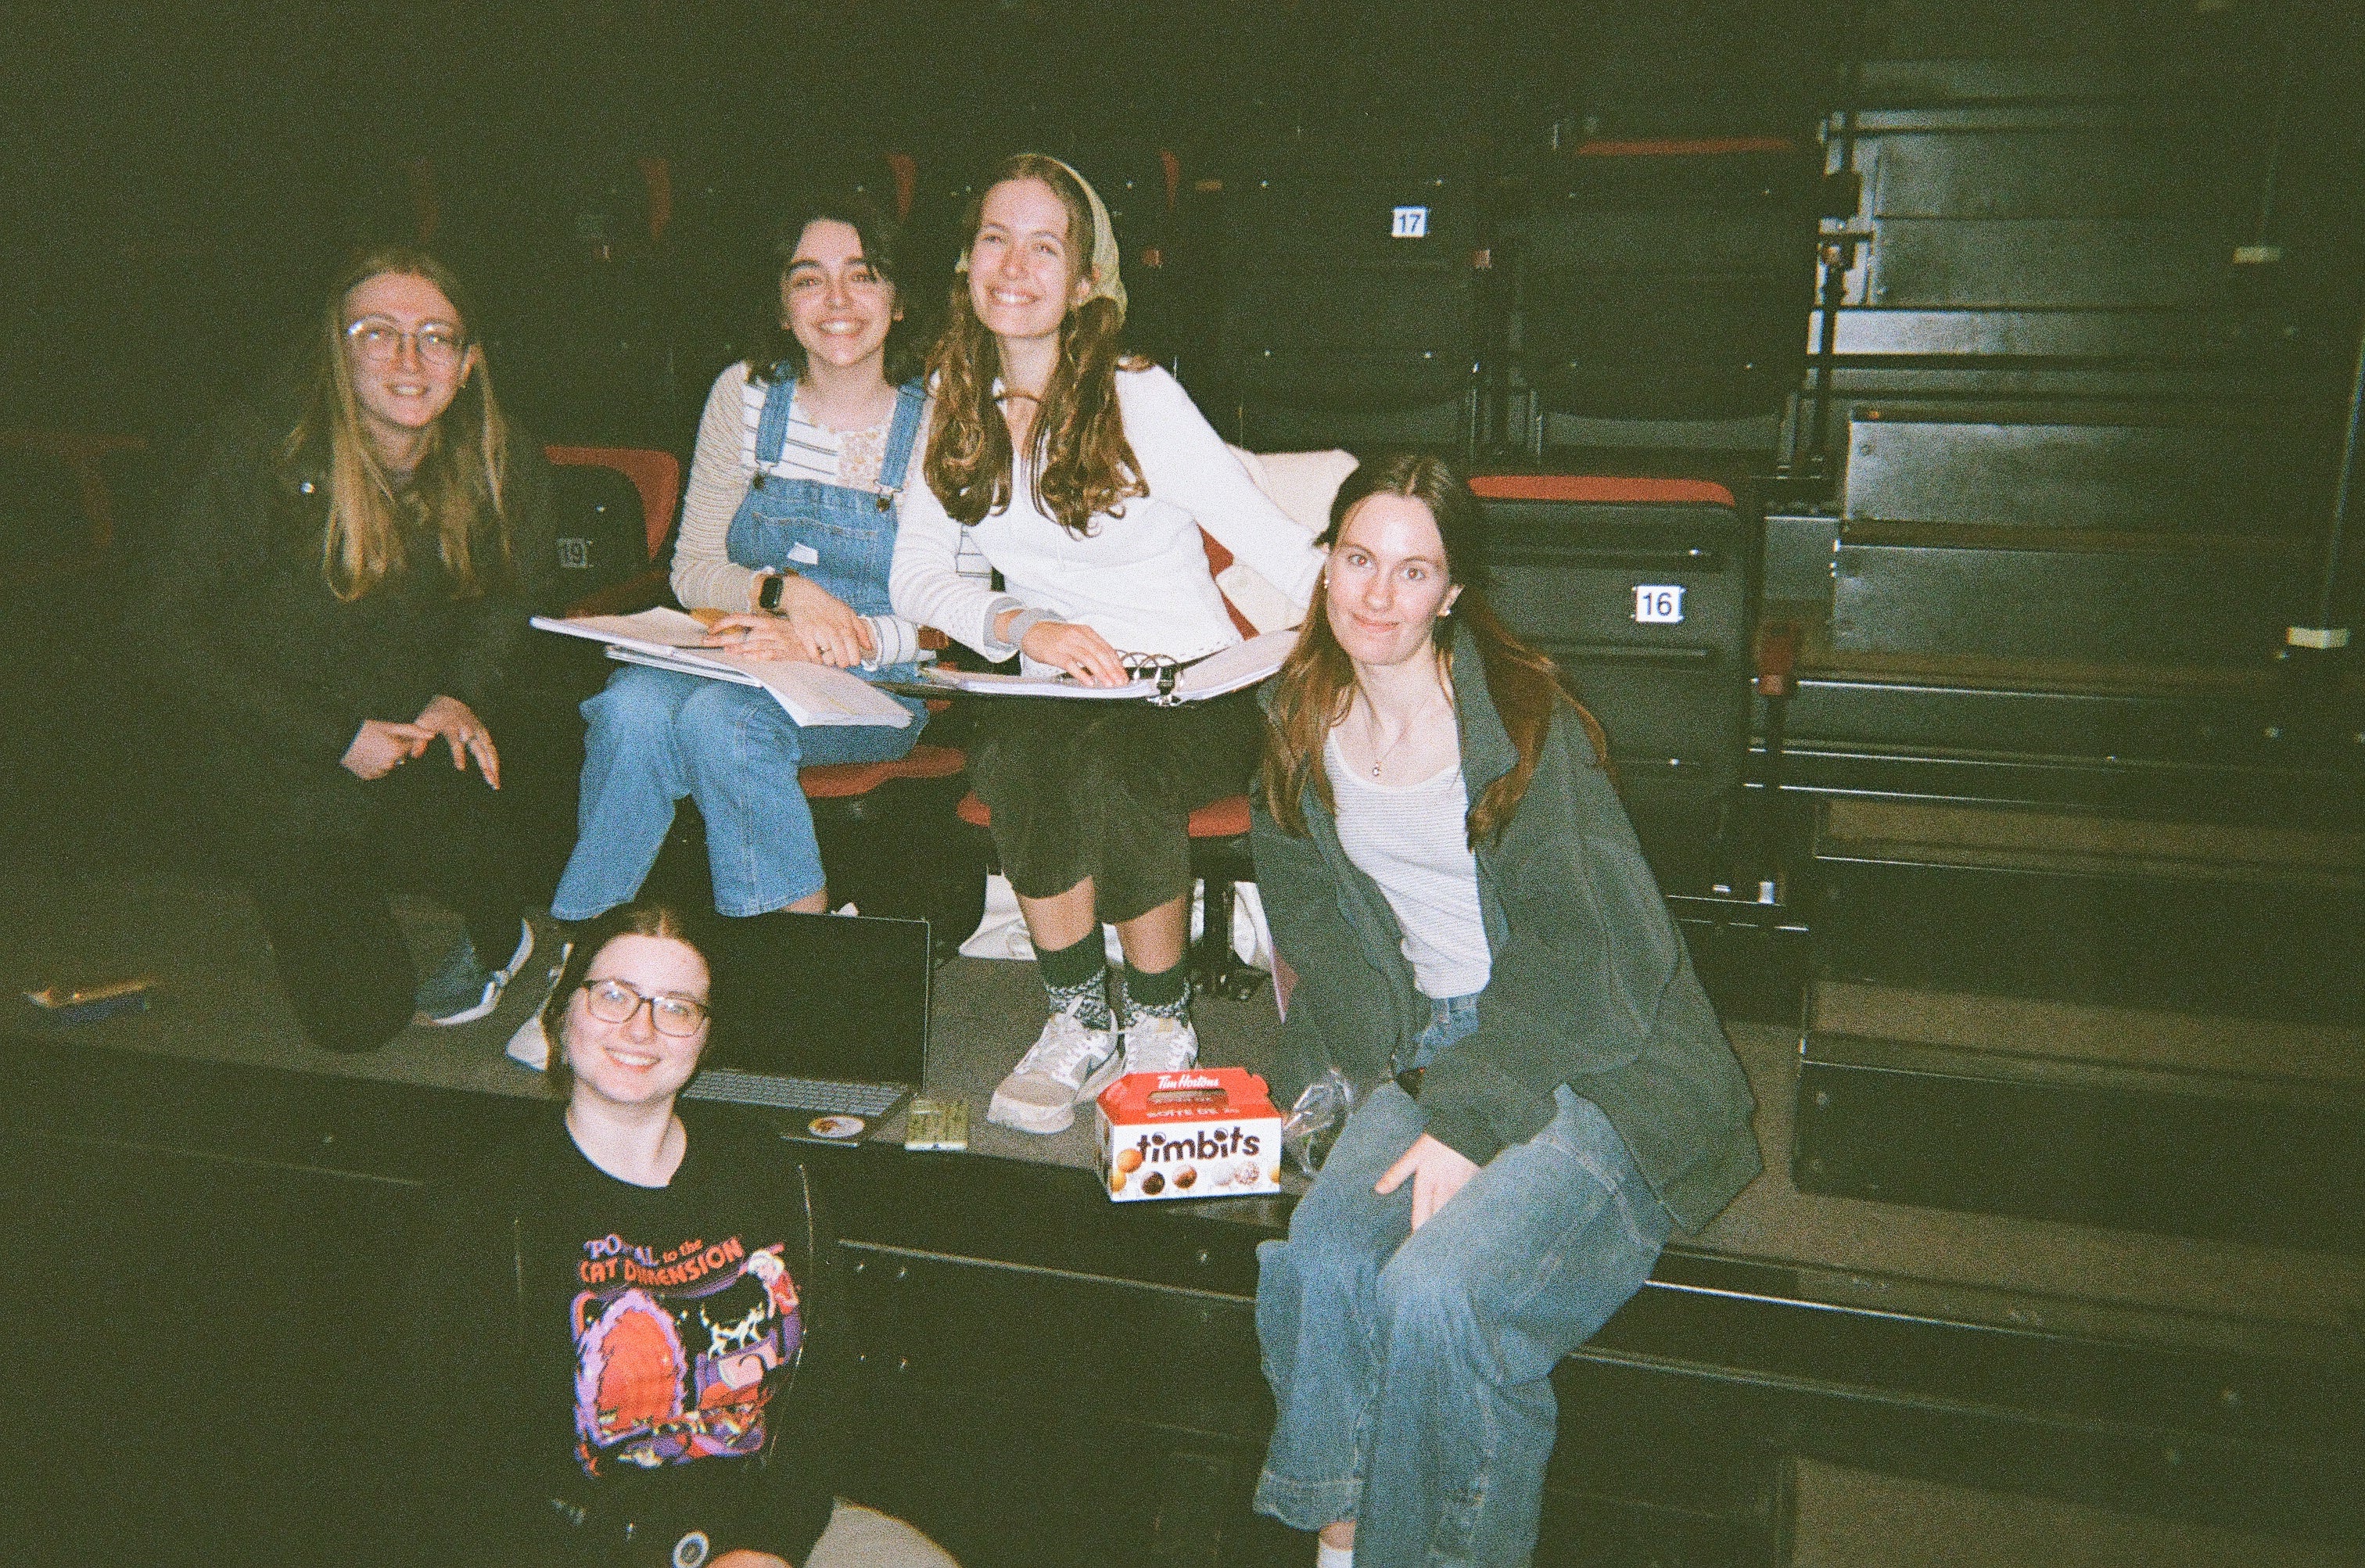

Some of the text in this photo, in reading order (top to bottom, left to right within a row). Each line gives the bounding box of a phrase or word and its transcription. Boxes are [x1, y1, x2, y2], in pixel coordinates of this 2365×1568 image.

[1399, 213, 1421, 233] 17
[565, 543, 582, 563] 19
[1642, 592, 1672, 616] 16
[1157, 1074, 1220, 1089] Tim Hortons
[1137, 1125, 1261, 1163] timbits
[662, 1249, 678, 1263] to
[679, 1238, 703, 1257] the
[580, 1257, 619, 1283] CAT
